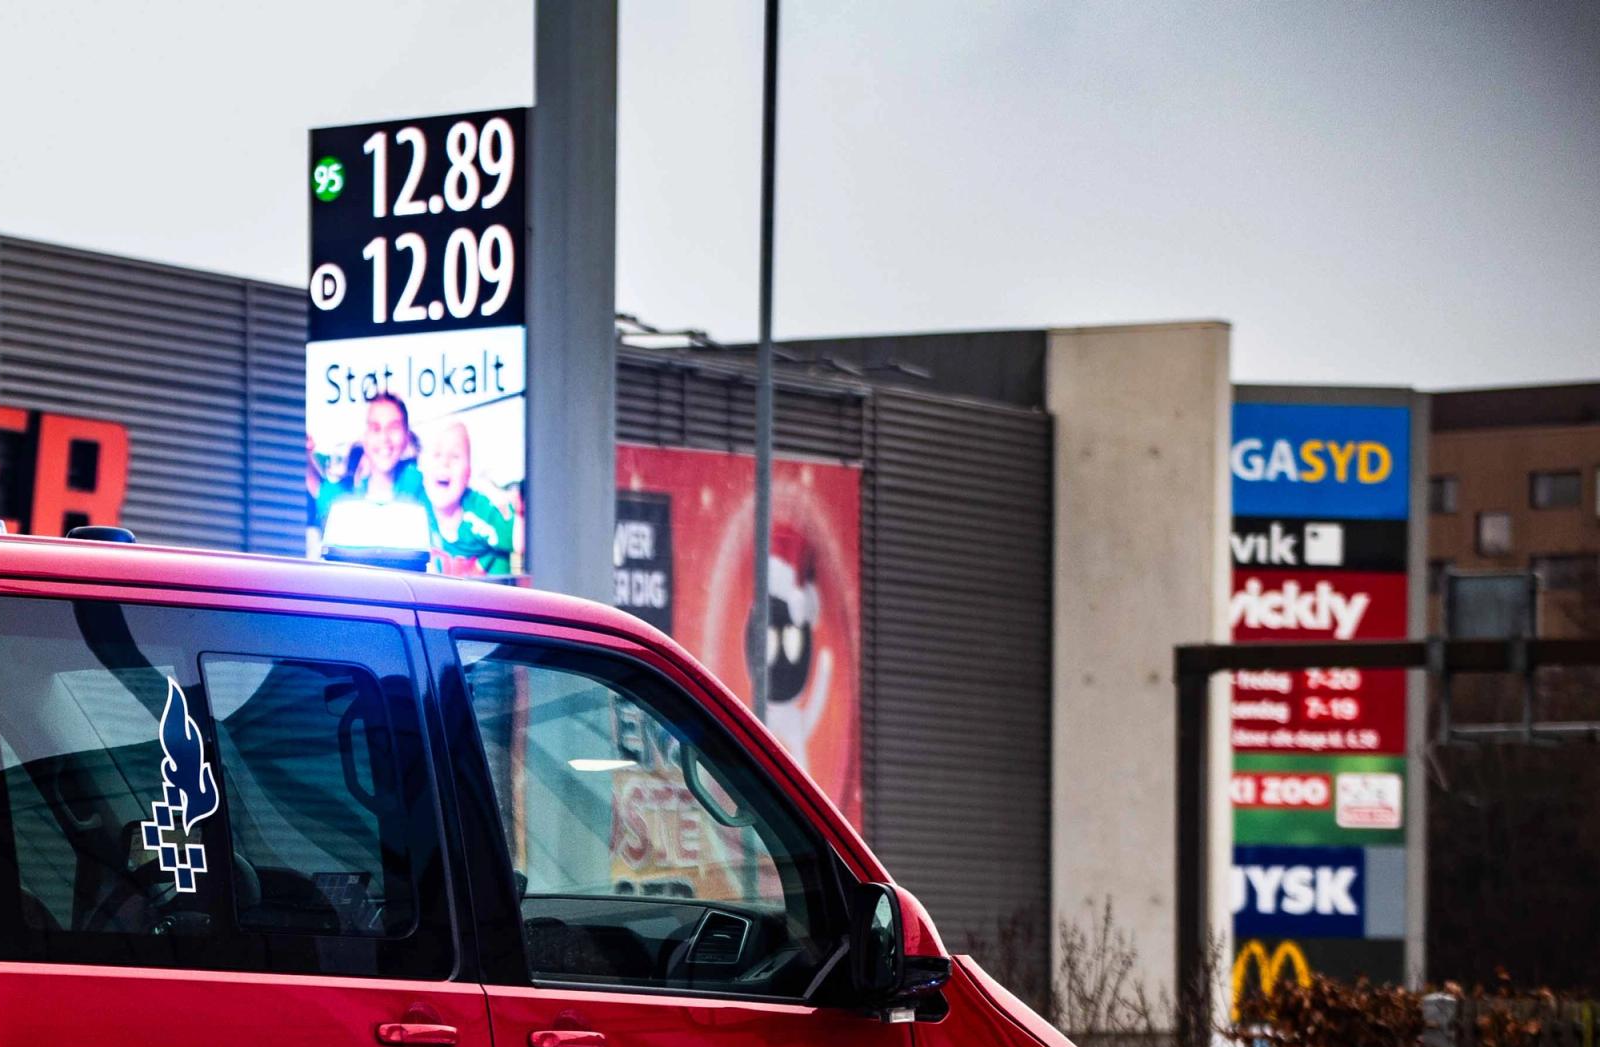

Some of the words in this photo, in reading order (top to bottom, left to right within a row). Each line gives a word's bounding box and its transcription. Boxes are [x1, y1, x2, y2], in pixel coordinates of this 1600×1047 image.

[313, 162, 344, 193] 95
[363, 117, 515, 218] 12.89
[363, 224, 515, 324] 12.09
[408, 350, 505, 398] lokalt
